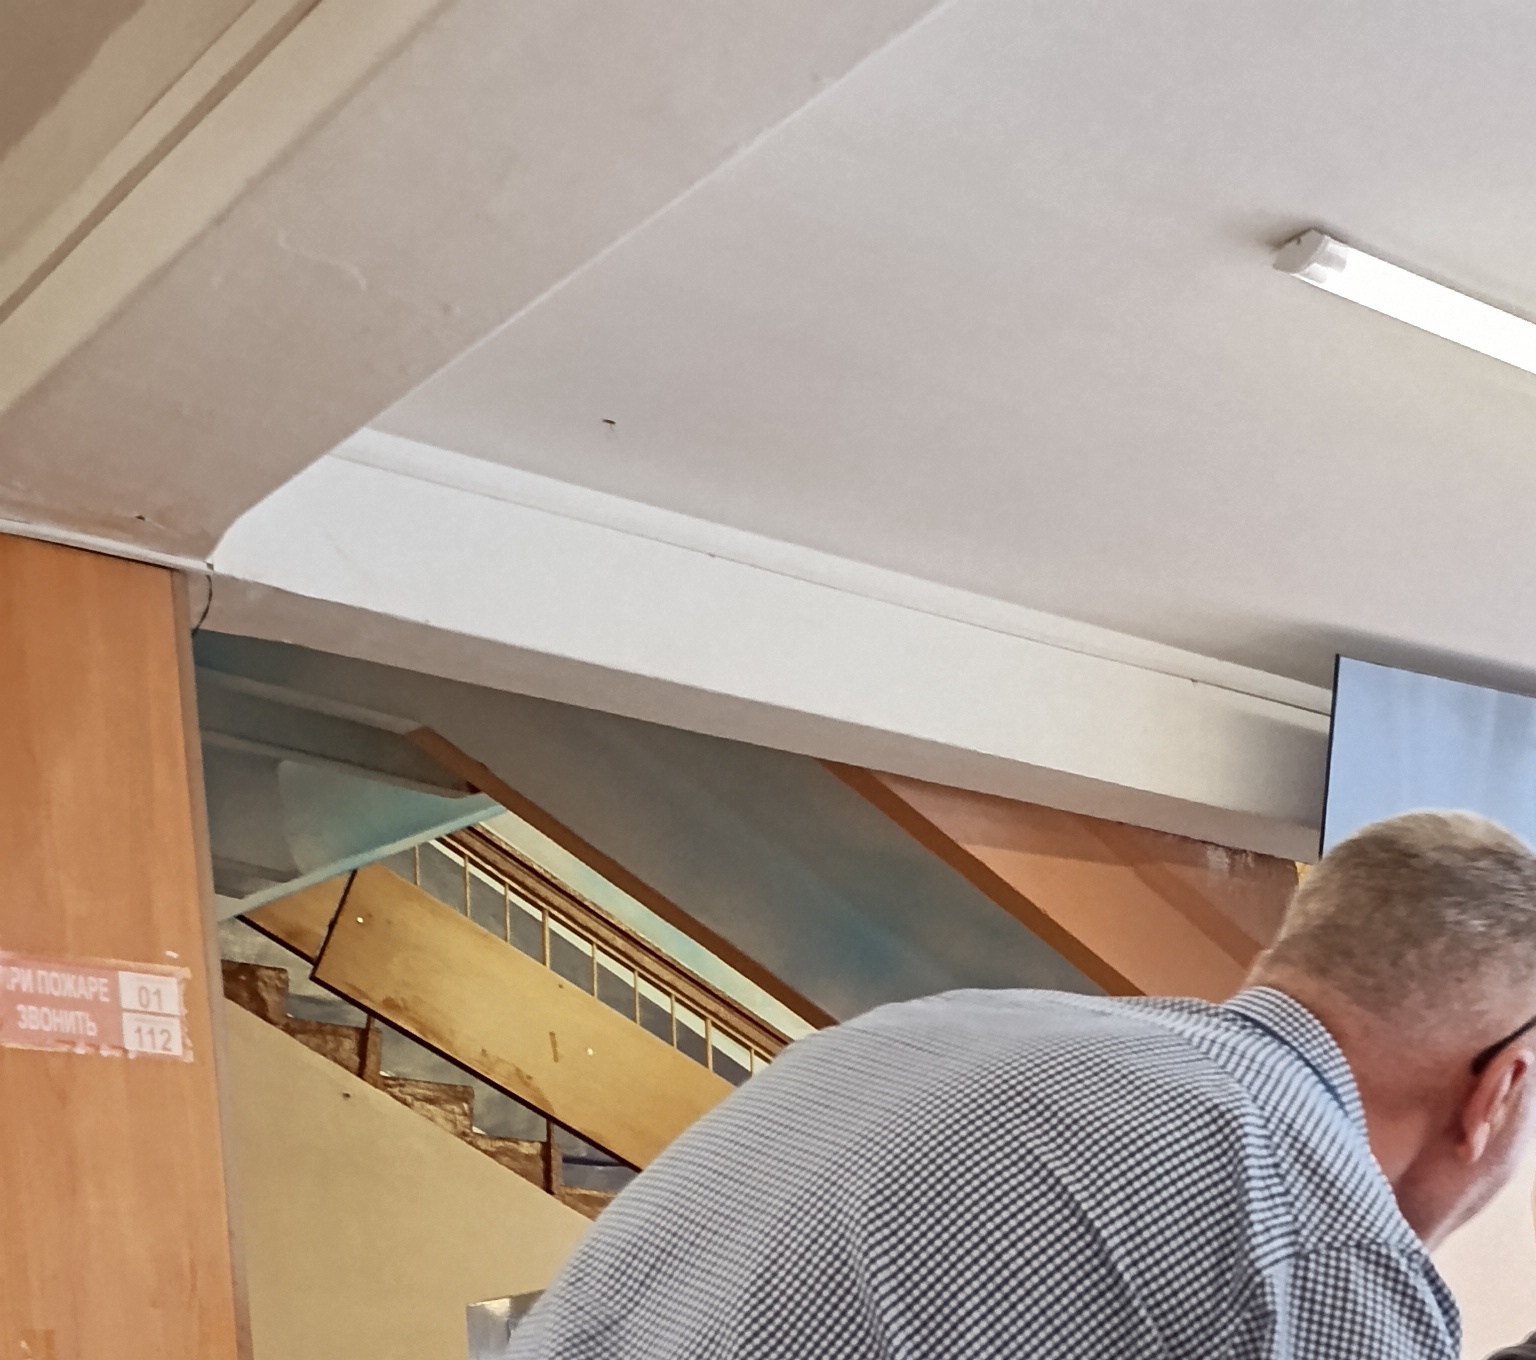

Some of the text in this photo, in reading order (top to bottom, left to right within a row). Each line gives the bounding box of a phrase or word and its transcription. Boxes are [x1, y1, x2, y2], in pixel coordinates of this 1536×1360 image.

[0, 966, 110, 1002] РИ ПОЖАРЕ
[137, 985, 163, 1011] 01
[16, 1004, 97, 1036] ЗВОНИТЬ
[133, 1026, 173, 1052] 112
